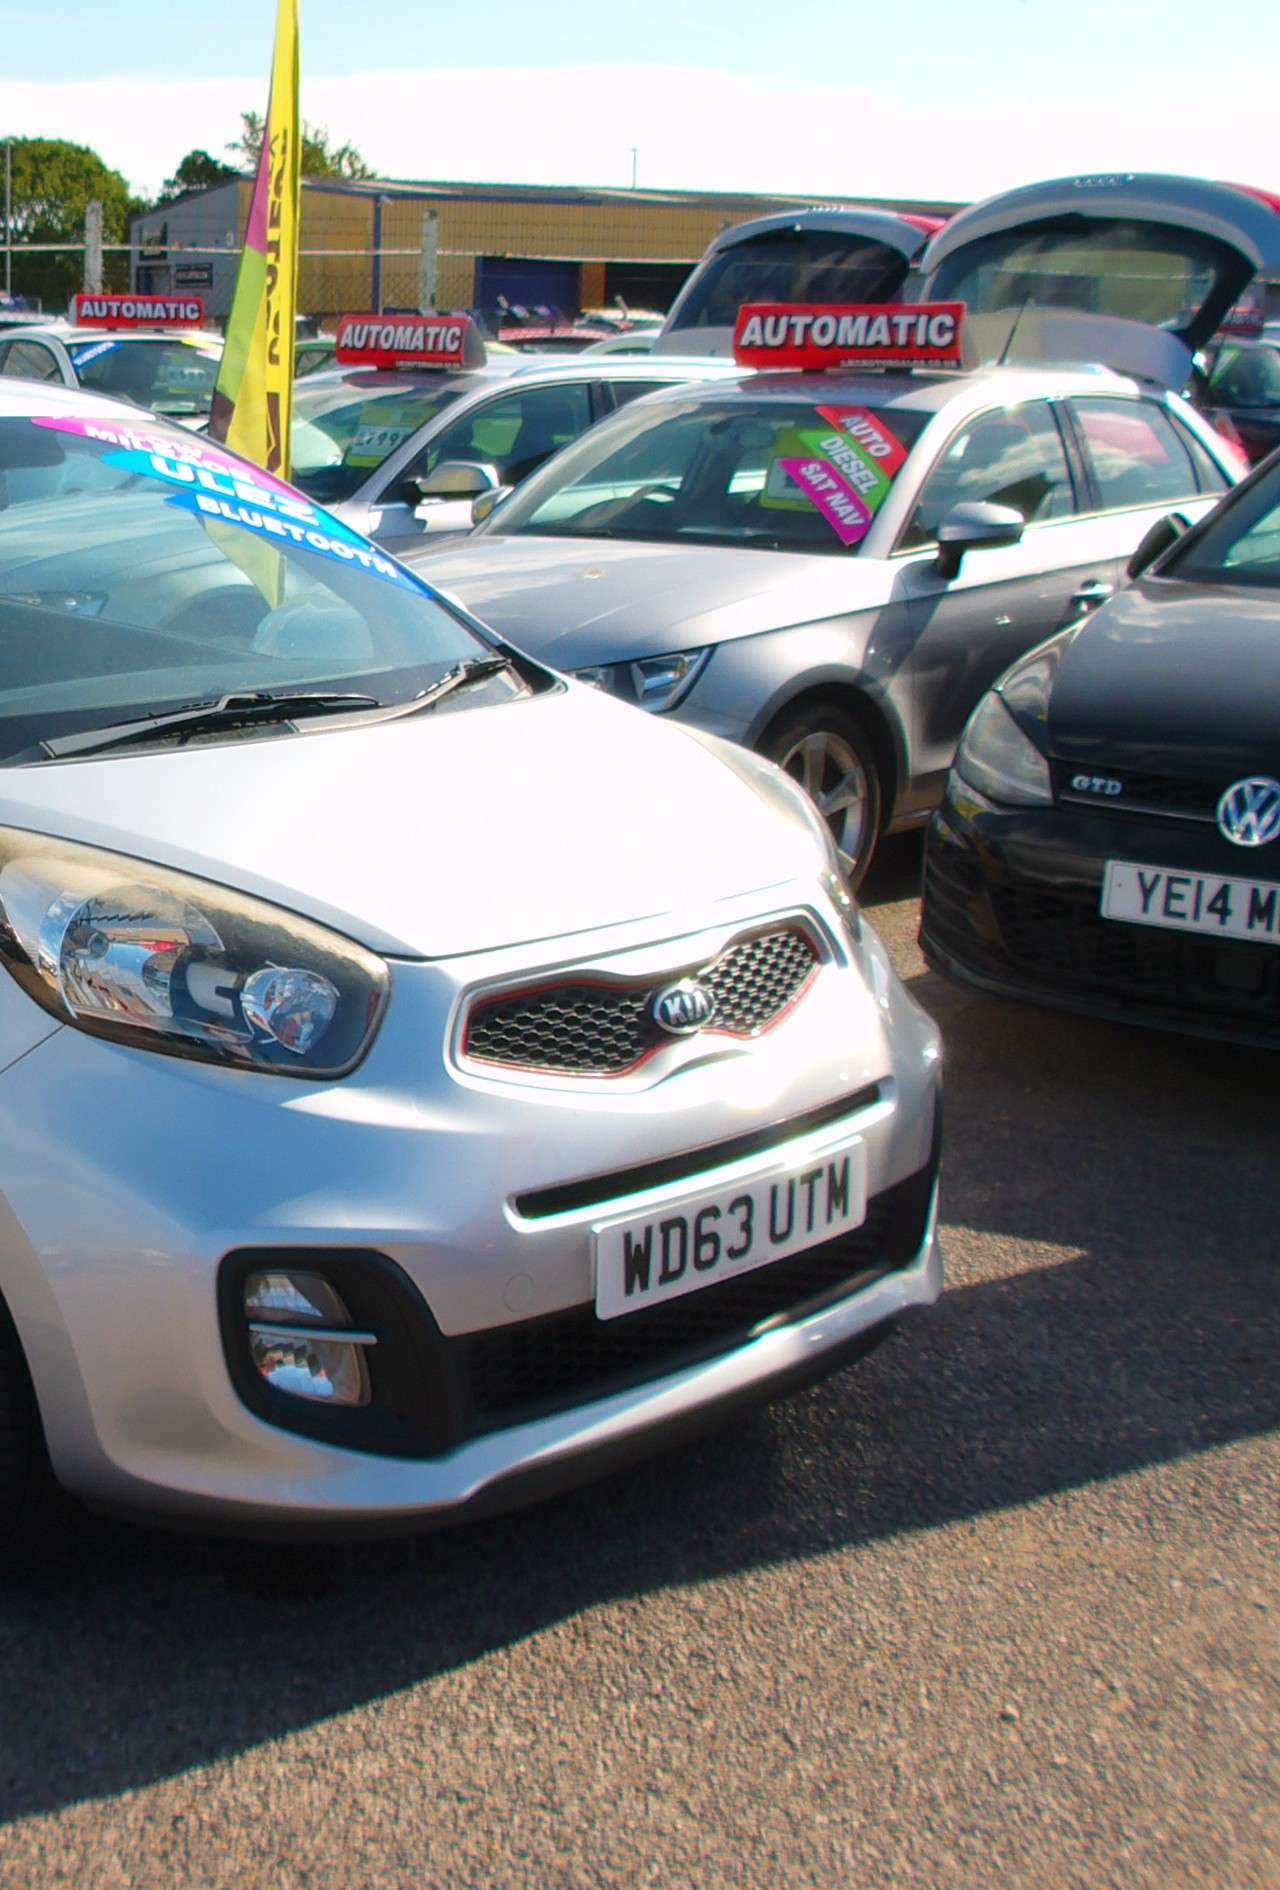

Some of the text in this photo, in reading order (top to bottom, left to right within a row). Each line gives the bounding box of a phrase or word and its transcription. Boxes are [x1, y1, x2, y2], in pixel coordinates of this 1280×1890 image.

[81, 301, 199, 320] AUTOMATIC
[740, 313, 955, 347] AUTOMATIC
[340, 324, 461, 352] AUTOMATIC
[840, 415, 891, 457] AUTO
[150, 454, 320, 526] ULEZ
[820, 436, 879, 494] DIESEL
[800, 463, 864, 525] SAT NAV
[196, 494, 399, 579] BLUETOOTH
[1072, 773, 1122, 796] GTD
[1137, 871, 1280, 934] YE14 M
[663, 990, 710, 1025] KIA
[623, 1157, 851, 1298] WD63 UTM
